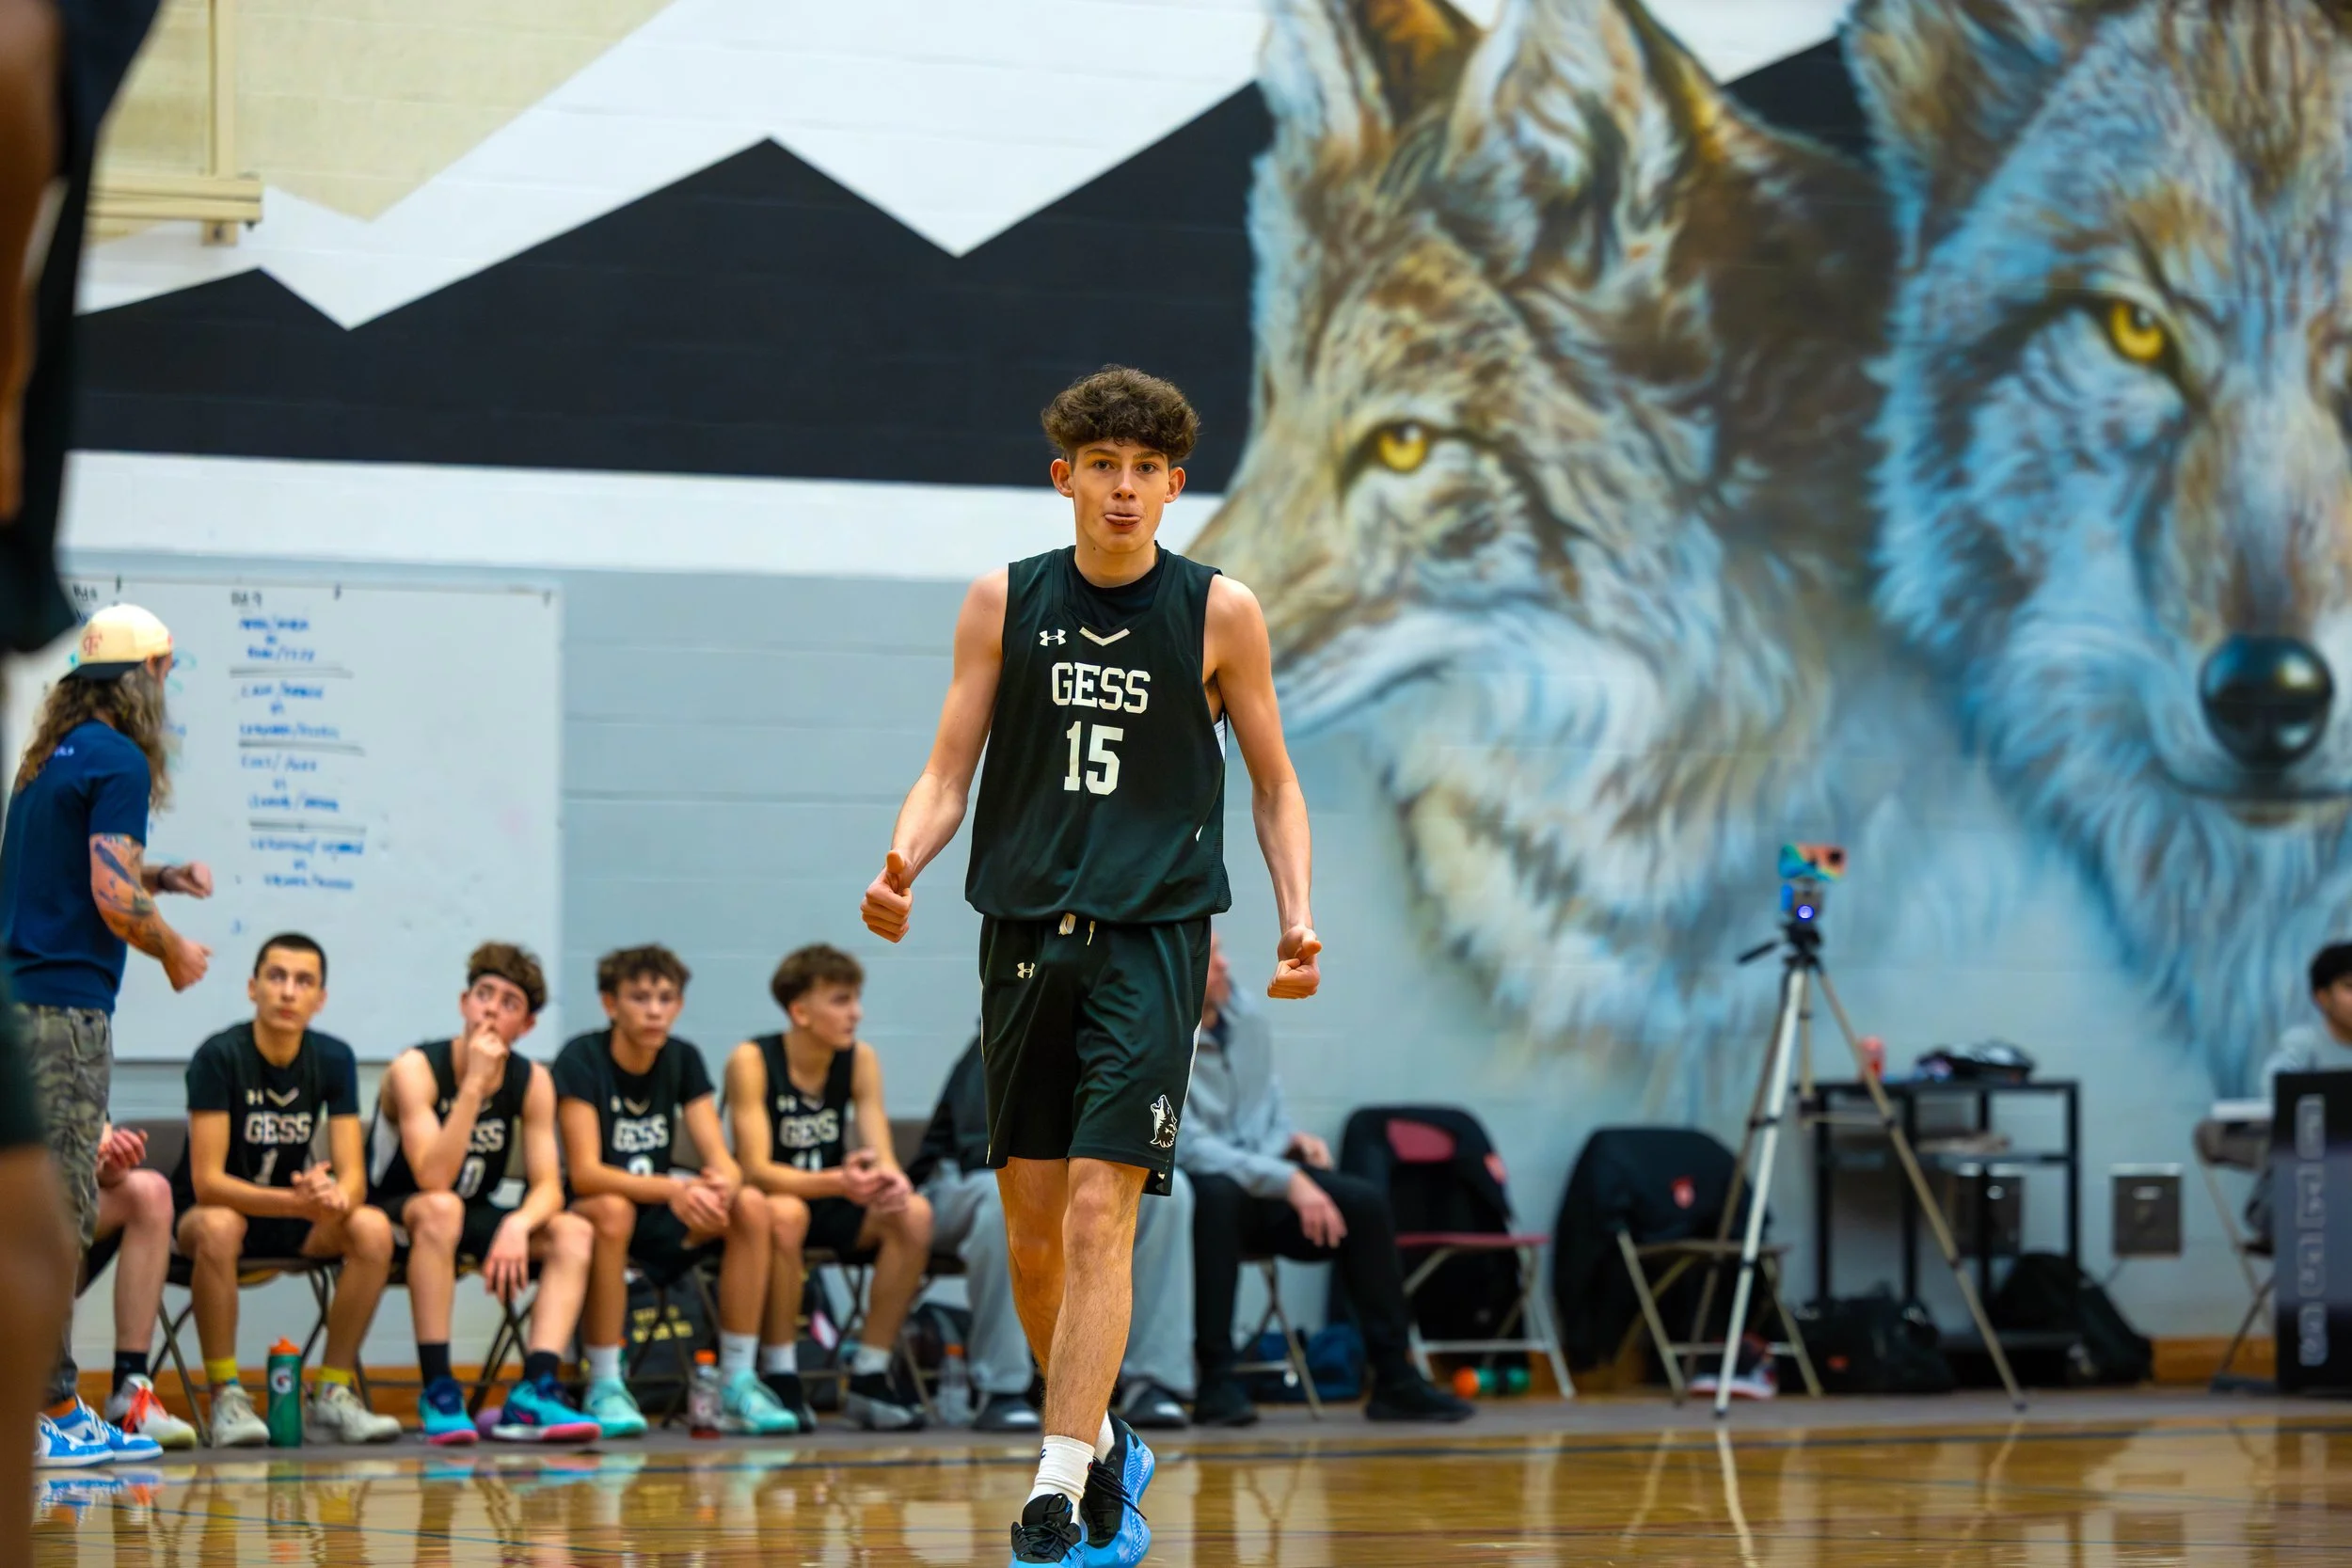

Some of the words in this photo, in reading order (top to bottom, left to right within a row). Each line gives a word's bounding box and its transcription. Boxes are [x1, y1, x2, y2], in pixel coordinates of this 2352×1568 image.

[1052, 661, 1151, 714] GESS
[1064, 721, 1123, 795] 15
[245, 1110, 312, 1145] GESS
[612, 1113, 669, 1153] GESS
[779, 1108, 839, 1148] GESS
[254, 1148, 278, 1185] 1
